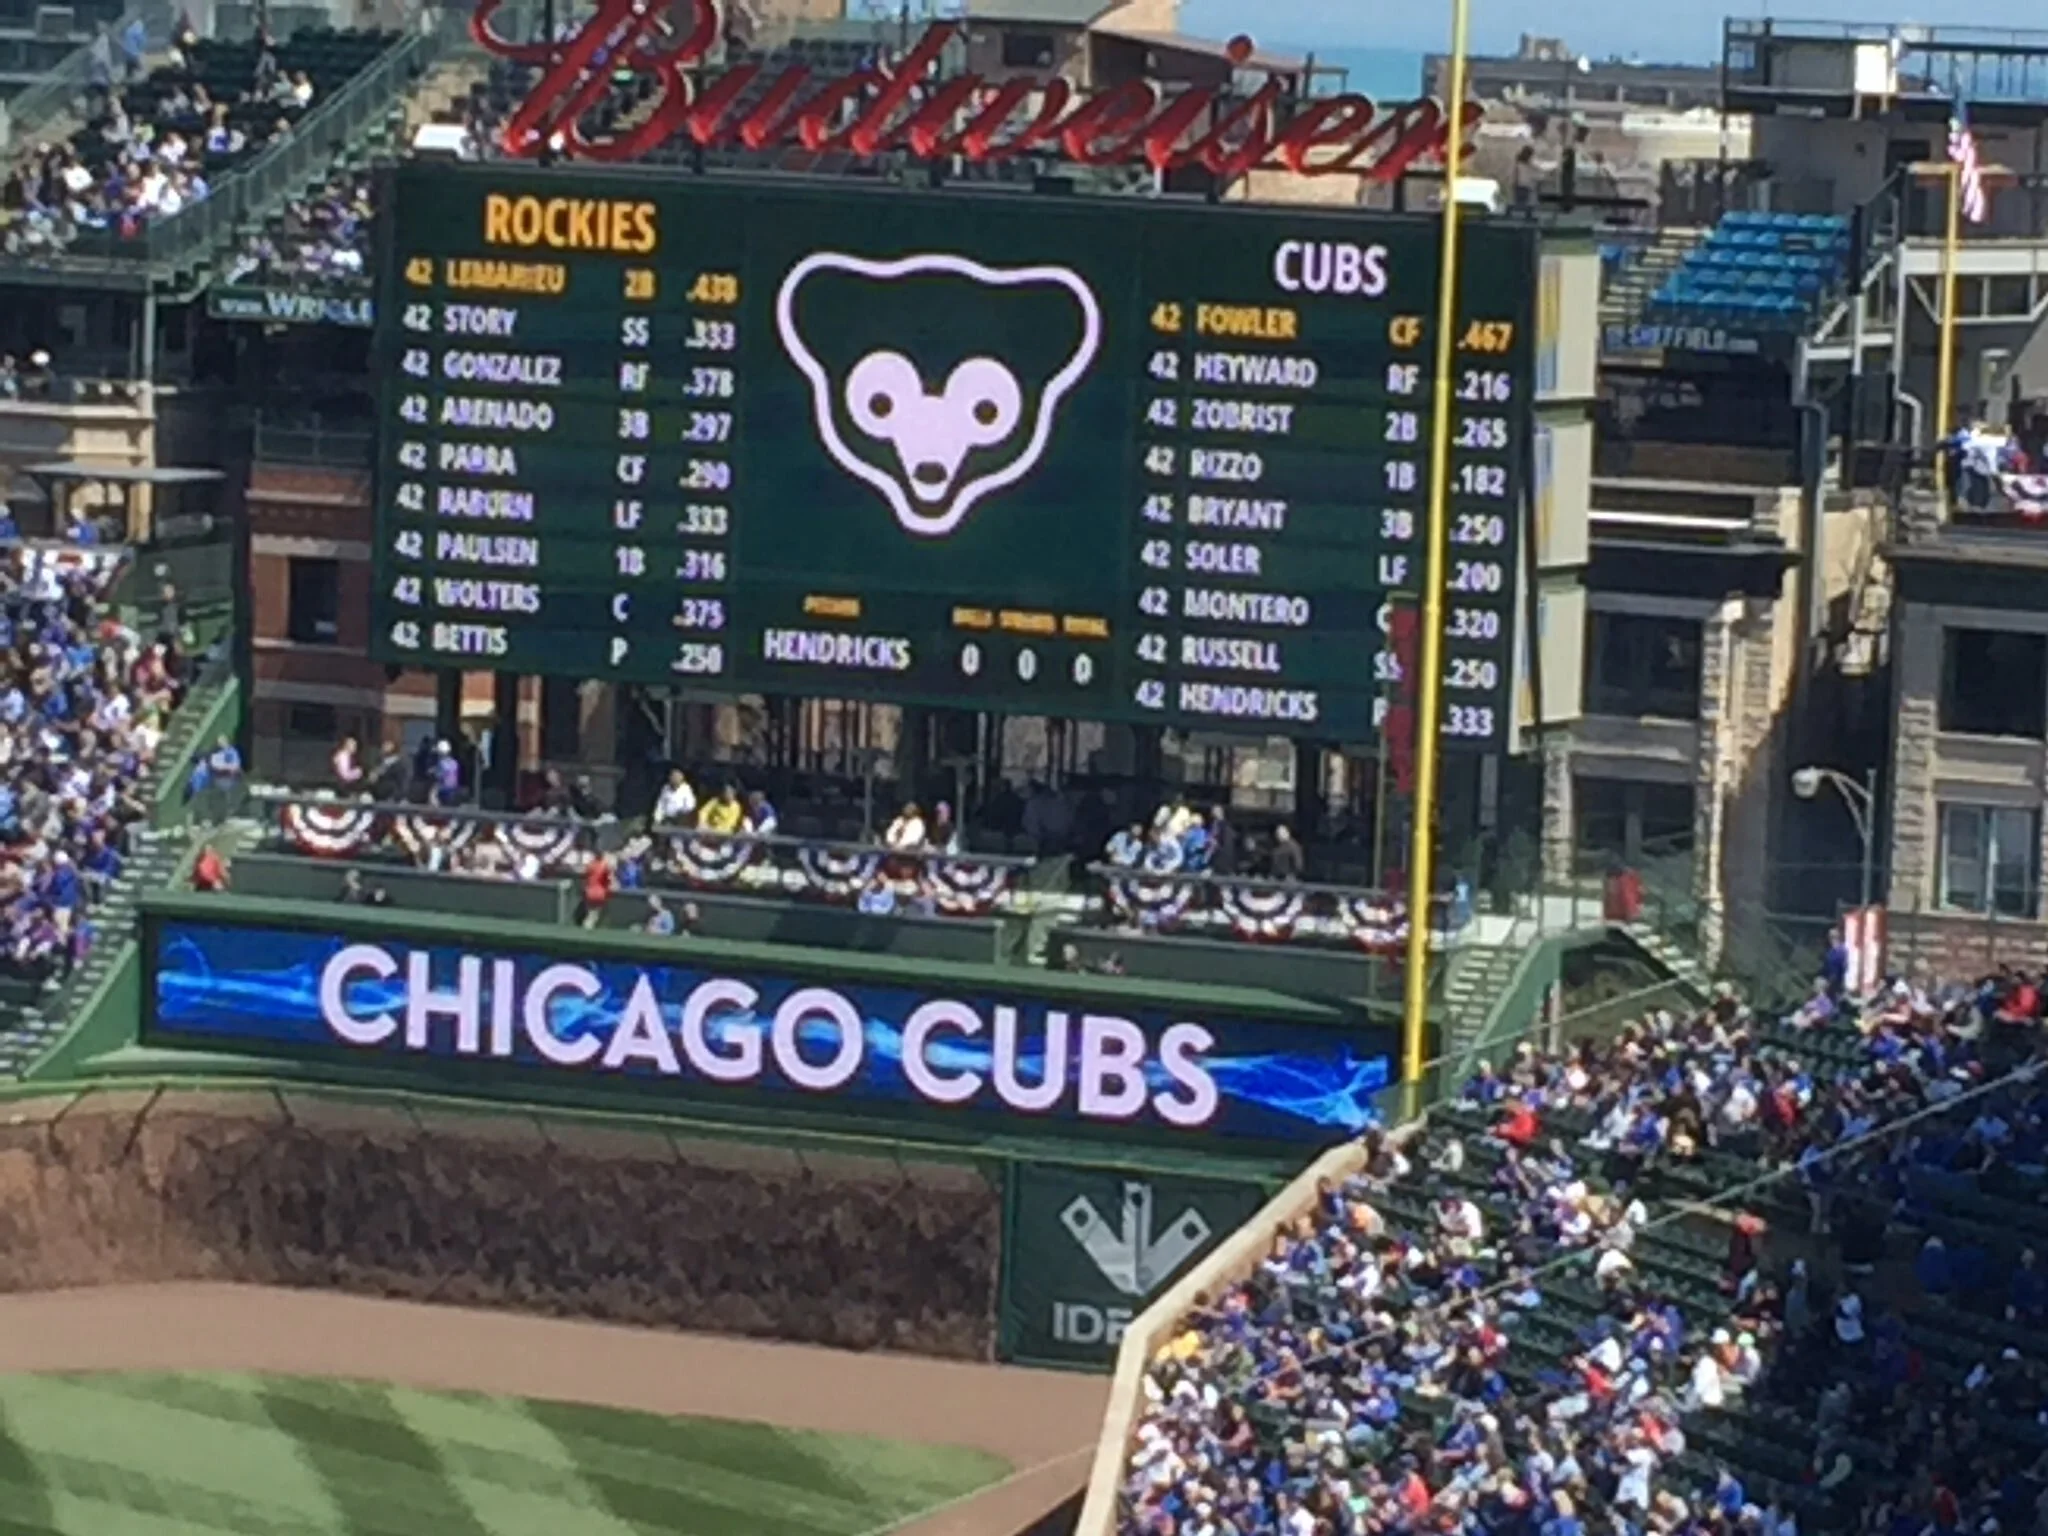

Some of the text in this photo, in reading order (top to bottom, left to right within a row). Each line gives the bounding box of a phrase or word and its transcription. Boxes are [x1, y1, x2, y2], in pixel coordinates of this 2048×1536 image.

[472, 0, 1484, 182] Budweiser
[484, 195, 656, 251] ROCKIES
[406, 258, 433, 285] 42
[625, 269, 655, 298] 2B
[1274, 239, 1389, 296] CUBS
[403, 304, 735, 349] 42 STORY SS .333
[1151, 303, 1513, 352] 42 FOWLER CF .467
[402, 350, 734, 397] 42 GONZALEZ RF .378
[1149, 351, 1511, 402] 42 HEYWARD RF .216
[400, 396, 732, 442] 42 ARENADO 3B .297
[1147, 398, 1508, 448] 42 ZOBRIST 2B .265
[398, 442, 731, 489] 42 PARRA CF .290
[1144, 446, 1505, 495] 42 RIZZO 1B .182
[397, 483, 425, 510] 42
[614, 500, 643, 530] LF
[677, 506, 728, 535] .333
[1142, 494, 1504, 545] 42 BRYANT 3B .250
[395, 531, 725, 580] 42 PAULSEN 1B .316
[1140, 540, 1502, 592] 42 SOLER LF .200
[393, 576, 725, 629] 42 WOLTERS C .375
[1138, 587, 1170, 616] 42
[1182, 588, 1310, 626] MONTERO
[1445, 608, 1499, 639] .320
[390, 621, 722, 673] 42 BETTIS P .250
[764, 628, 911, 671] HENDRICKS
[961, 642, 1094, 685] 0 0 0
[1135, 634, 1167, 663] 42
[1181, 635, 1281, 673] RUSSELL
[1443, 659, 1497, 690] .250
[1135, 681, 1165, 709] 42
[1179, 682, 1319, 721] HENDRICKS
[1441, 706, 1494, 737] .333
[318, 945, 1221, 1128] CHICAGO CUBS
